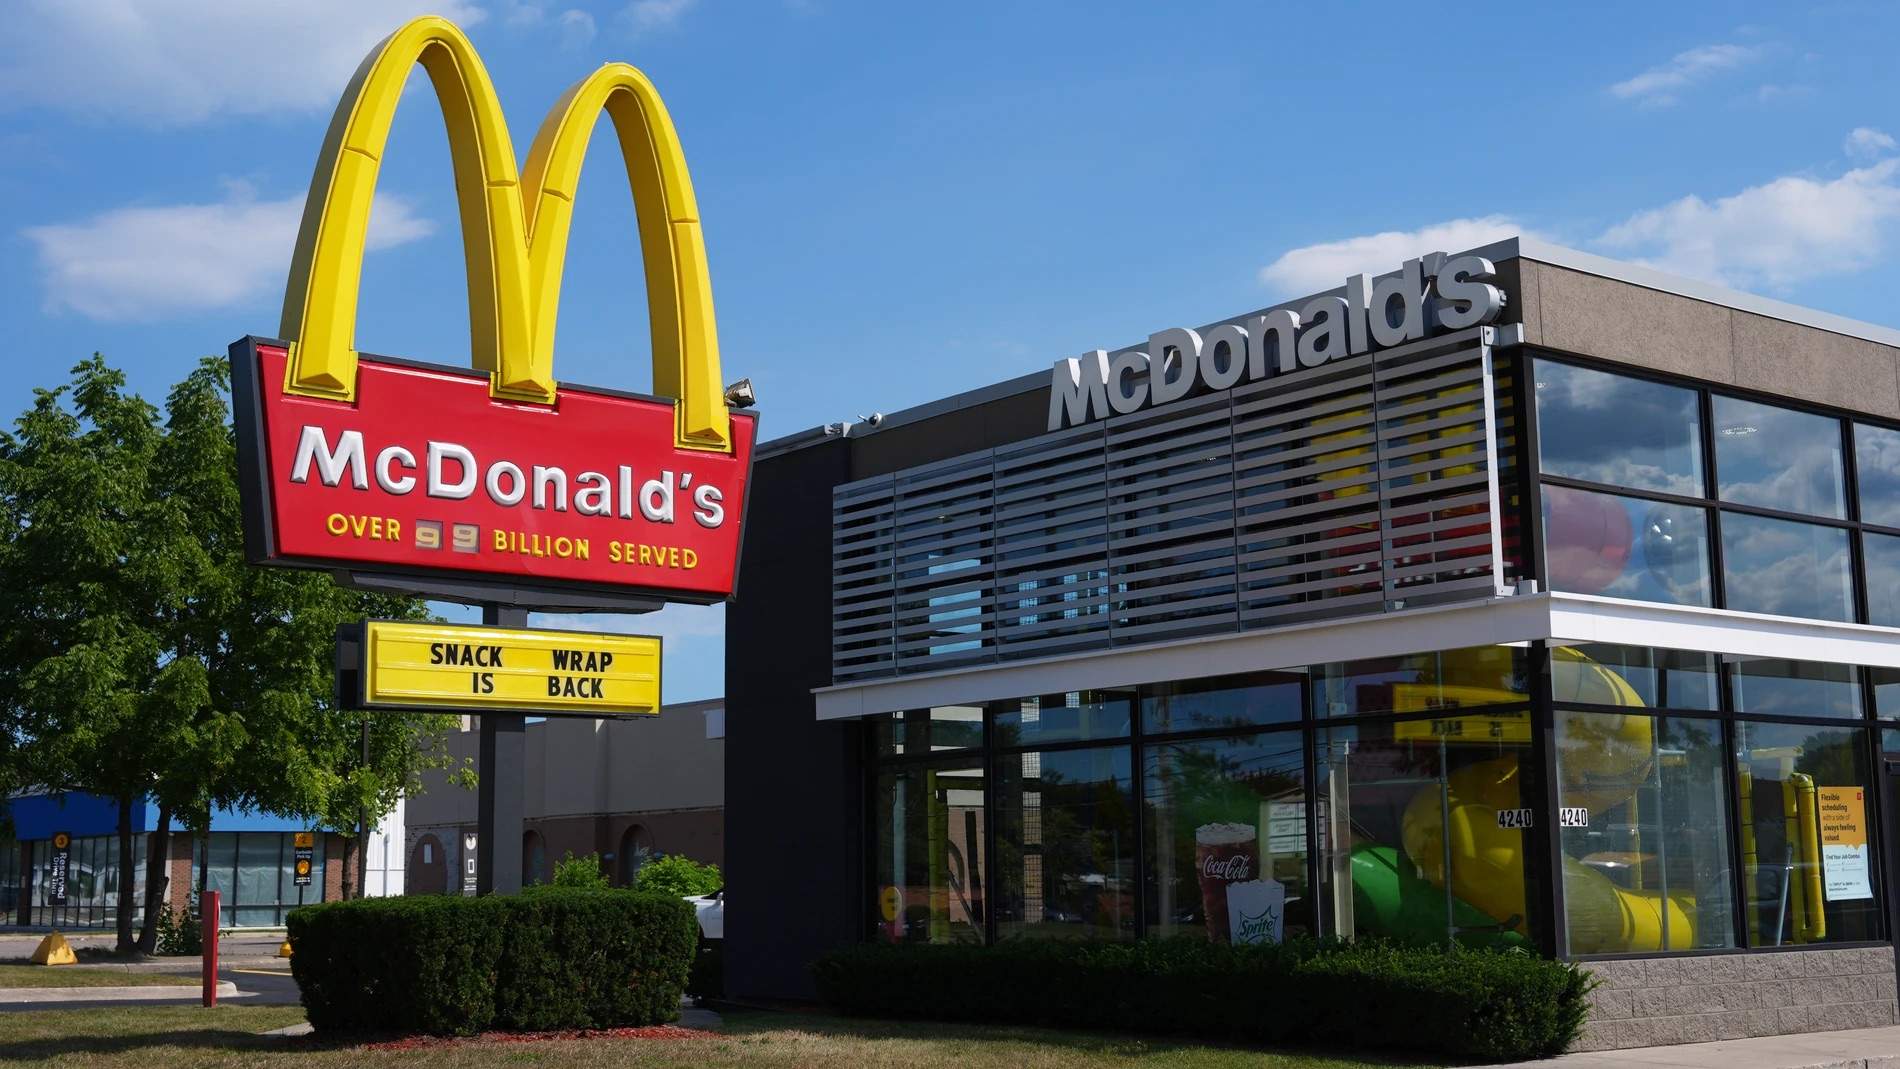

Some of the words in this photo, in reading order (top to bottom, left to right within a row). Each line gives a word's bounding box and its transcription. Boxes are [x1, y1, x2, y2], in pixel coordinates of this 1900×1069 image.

[1048, 251, 1502, 433] McDonald's
[290, 424, 725, 529] McDonald's
[327, 513, 401, 541] OVER
[493, 529, 590, 560] BILLION
[608, 540, 699, 570] SERVED
[430, 642, 503, 668] SNACK
[552, 649, 614, 673] WRAP
[472, 673, 495, 695] IS
[547, 674, 604, 699] BACK
[1499, 810, 1532, 828] 4240
[1560, 808, 1587, 826] 4240
[57, 852, 67, 899] Reserved
[1202, 855, 1250, 880] Coca-Cola
[1239, 919, 1274, 938] Sprite
